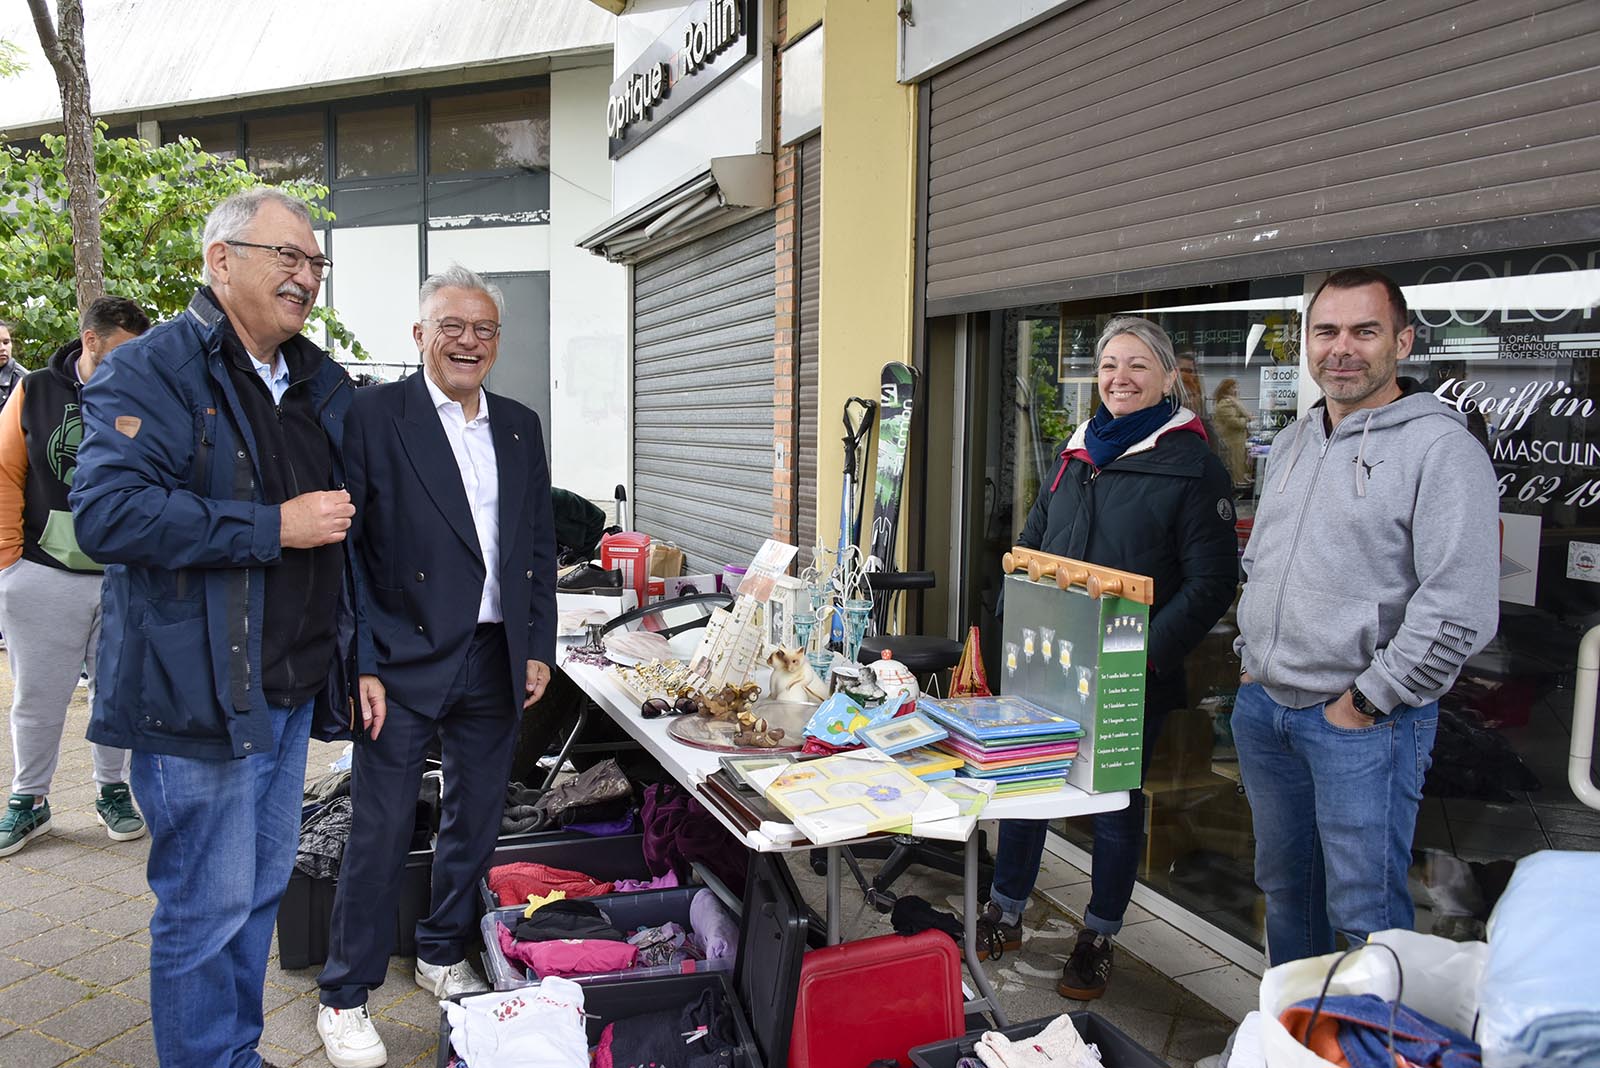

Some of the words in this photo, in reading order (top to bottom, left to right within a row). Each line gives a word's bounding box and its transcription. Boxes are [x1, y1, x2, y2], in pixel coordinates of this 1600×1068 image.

[607, 62, 664, 139] Optique
[678, 0, 736, 76] Rollin
[1500, 331, 1543, 345] L'ORÉAL
[1500, 342, 1558, 352] TECHNIQUE
[1500, 350, 1598, 360] PROFESSIONNELLE
[1278, 390, 1296, 398] 2026
[1518, 475, 1561, 504] 62
[1563, 479, 1600, 508] 19
